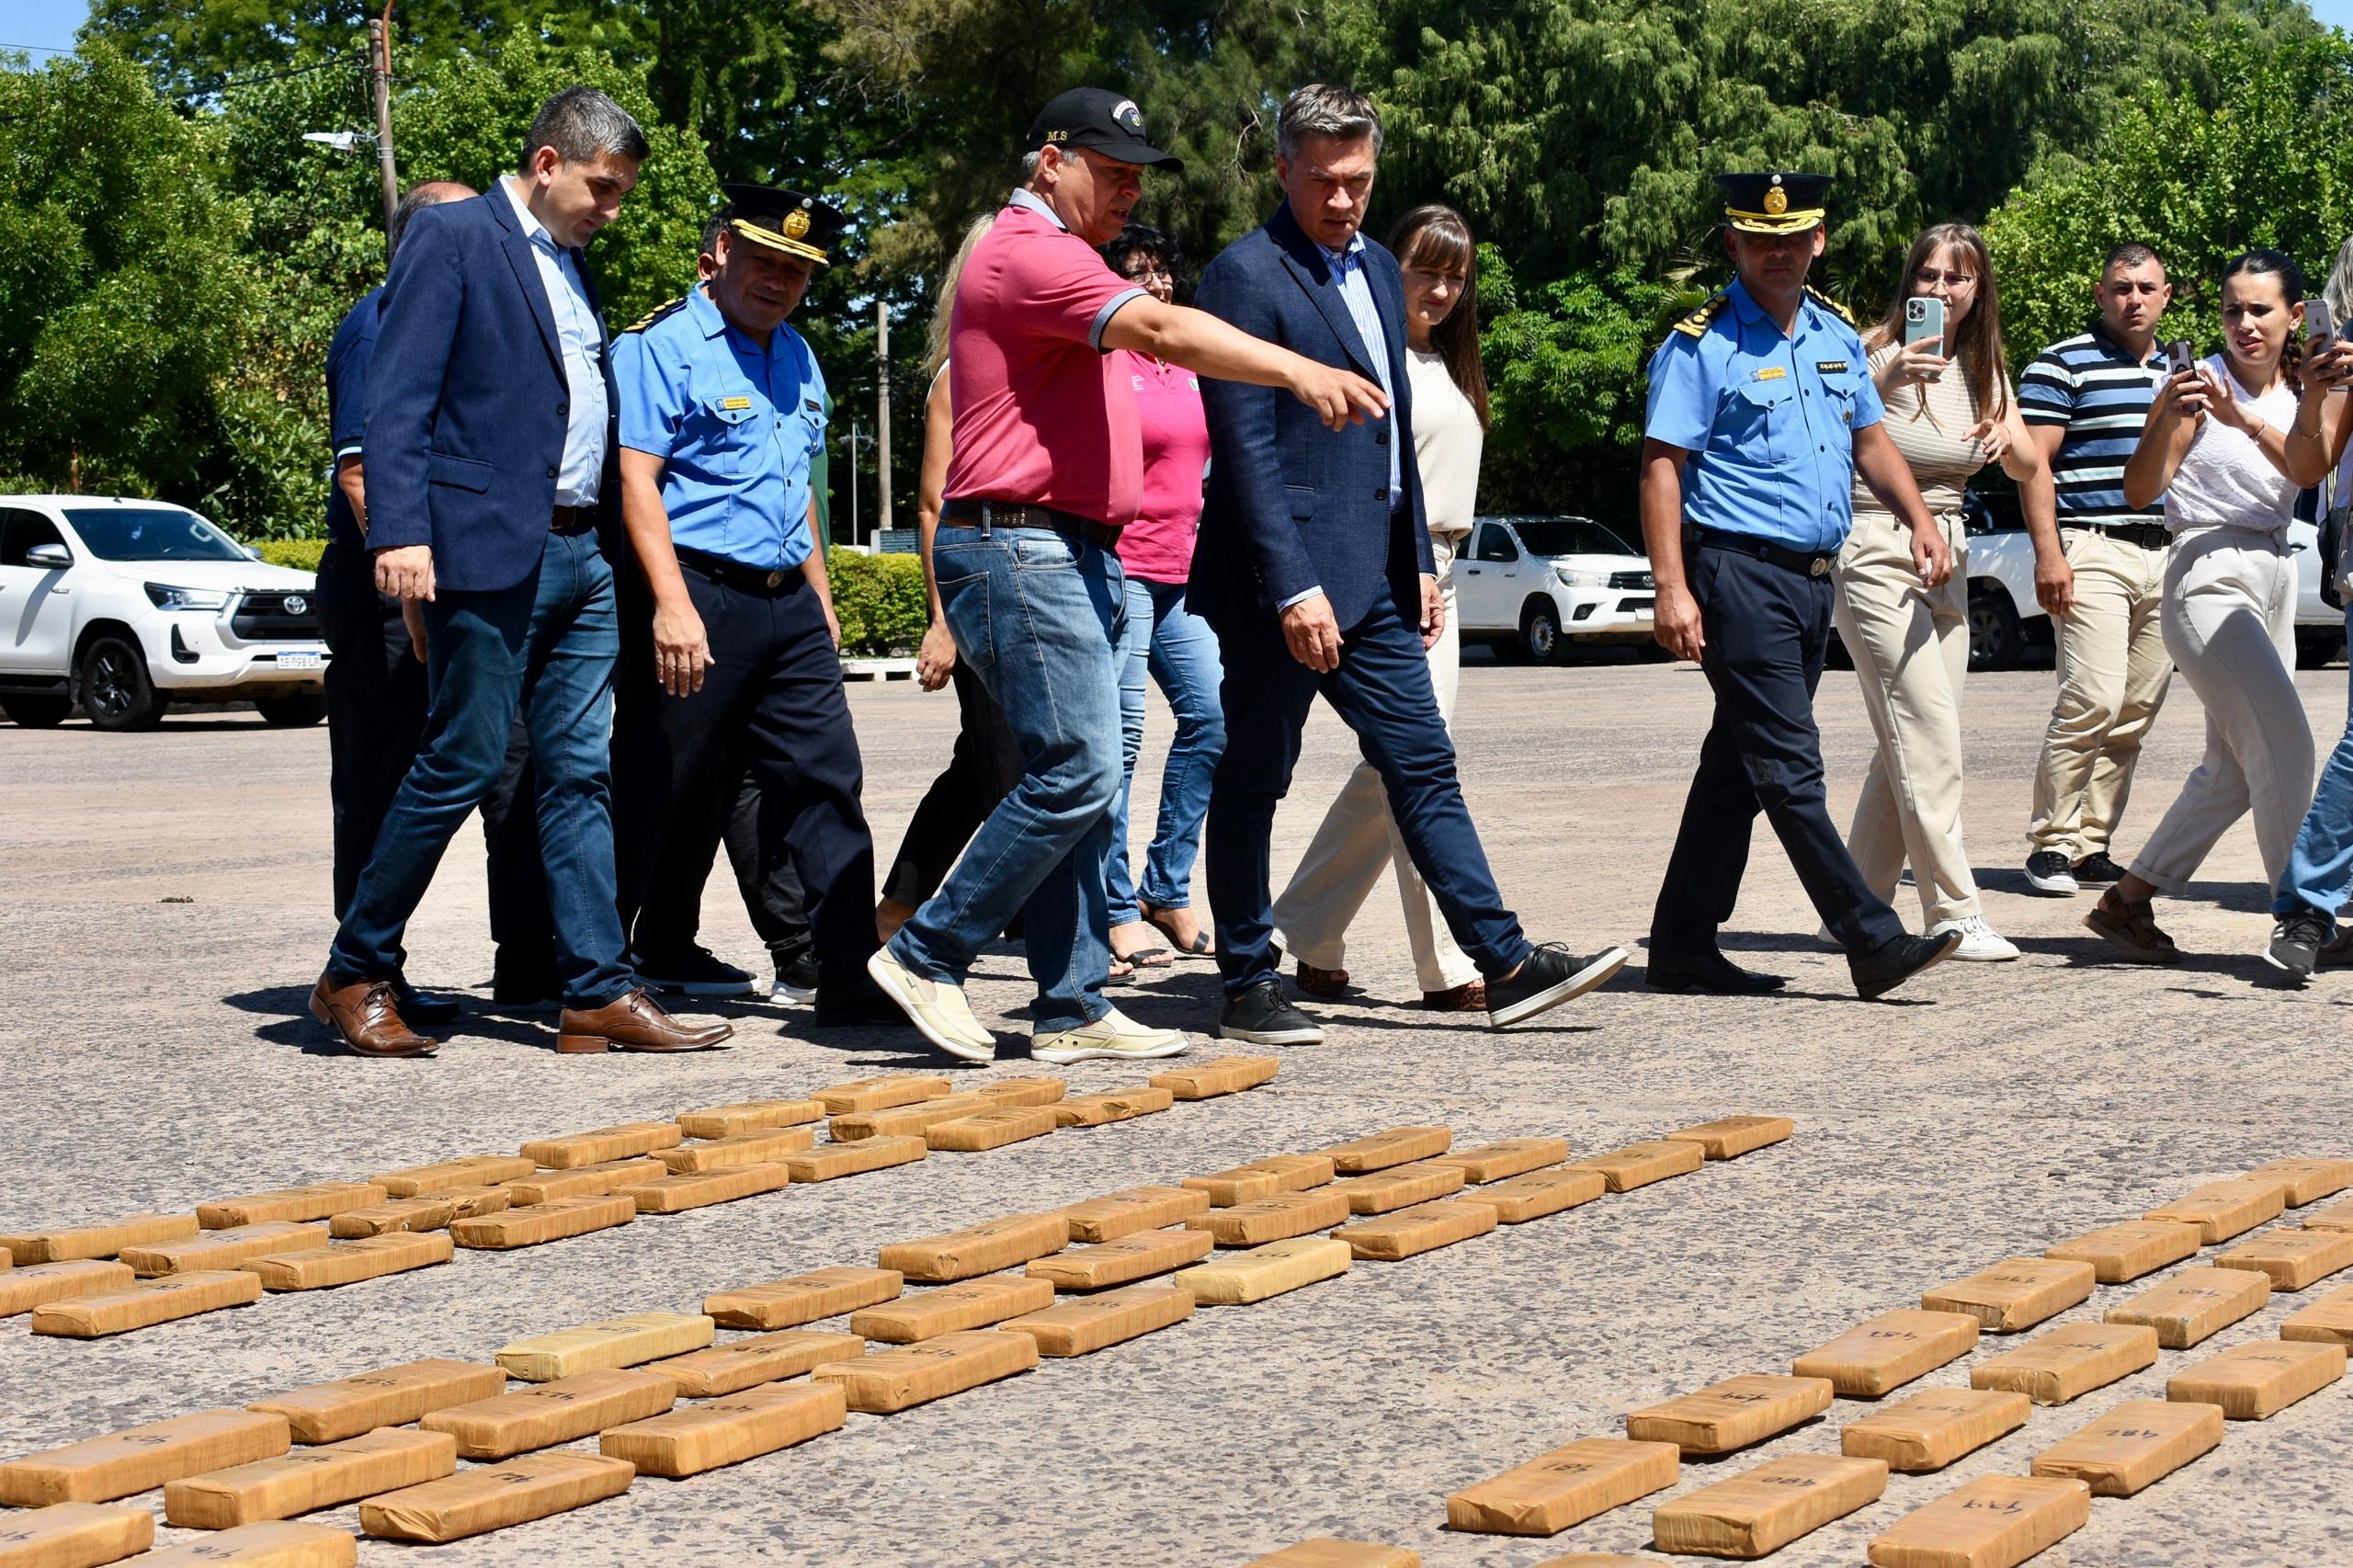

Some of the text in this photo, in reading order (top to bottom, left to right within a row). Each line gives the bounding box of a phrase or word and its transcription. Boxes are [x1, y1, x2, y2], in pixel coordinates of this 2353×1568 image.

[1046, 131, 1067, 142] M.S
[1870, 1332, 1917, 1341] 487
[522, 1390, 576, 1401] 425
[701, 1404, 754, 1413] 424
[2103, 1429, 2159, 1439] 482
[123, 1435, 172, 1445] 423
[1541, 1463, 1594, 1474] 481
[1762, 1477, 1815, 1487] 480
[1962, 1500, 2023, 1515] 479
